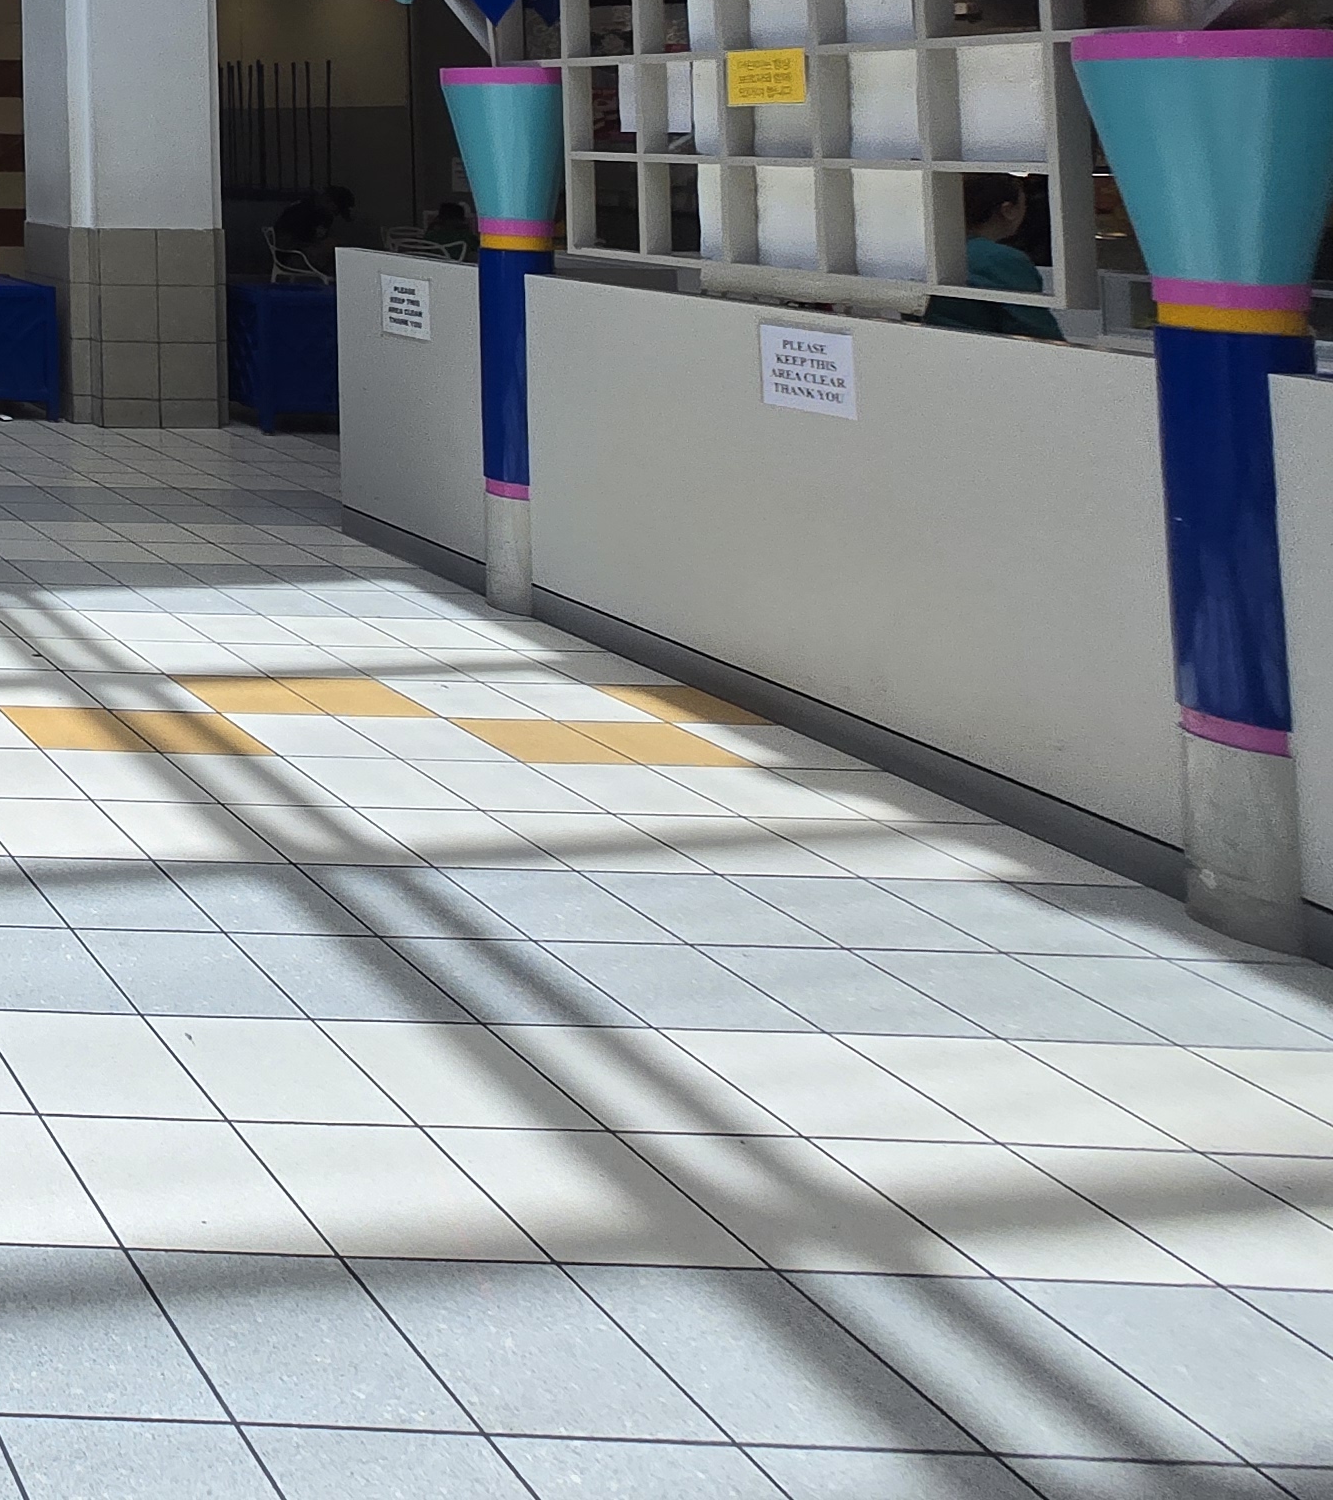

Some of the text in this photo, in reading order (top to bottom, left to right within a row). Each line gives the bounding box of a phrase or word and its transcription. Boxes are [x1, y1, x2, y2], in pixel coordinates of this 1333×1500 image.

[782, 339, 828, 355] PLEASE
[775, 353, 837, 372] KEEP THIS
[770, 368, 847, 389] AREA CLEAR
[774, 382, 844, 404] THANK YOU
